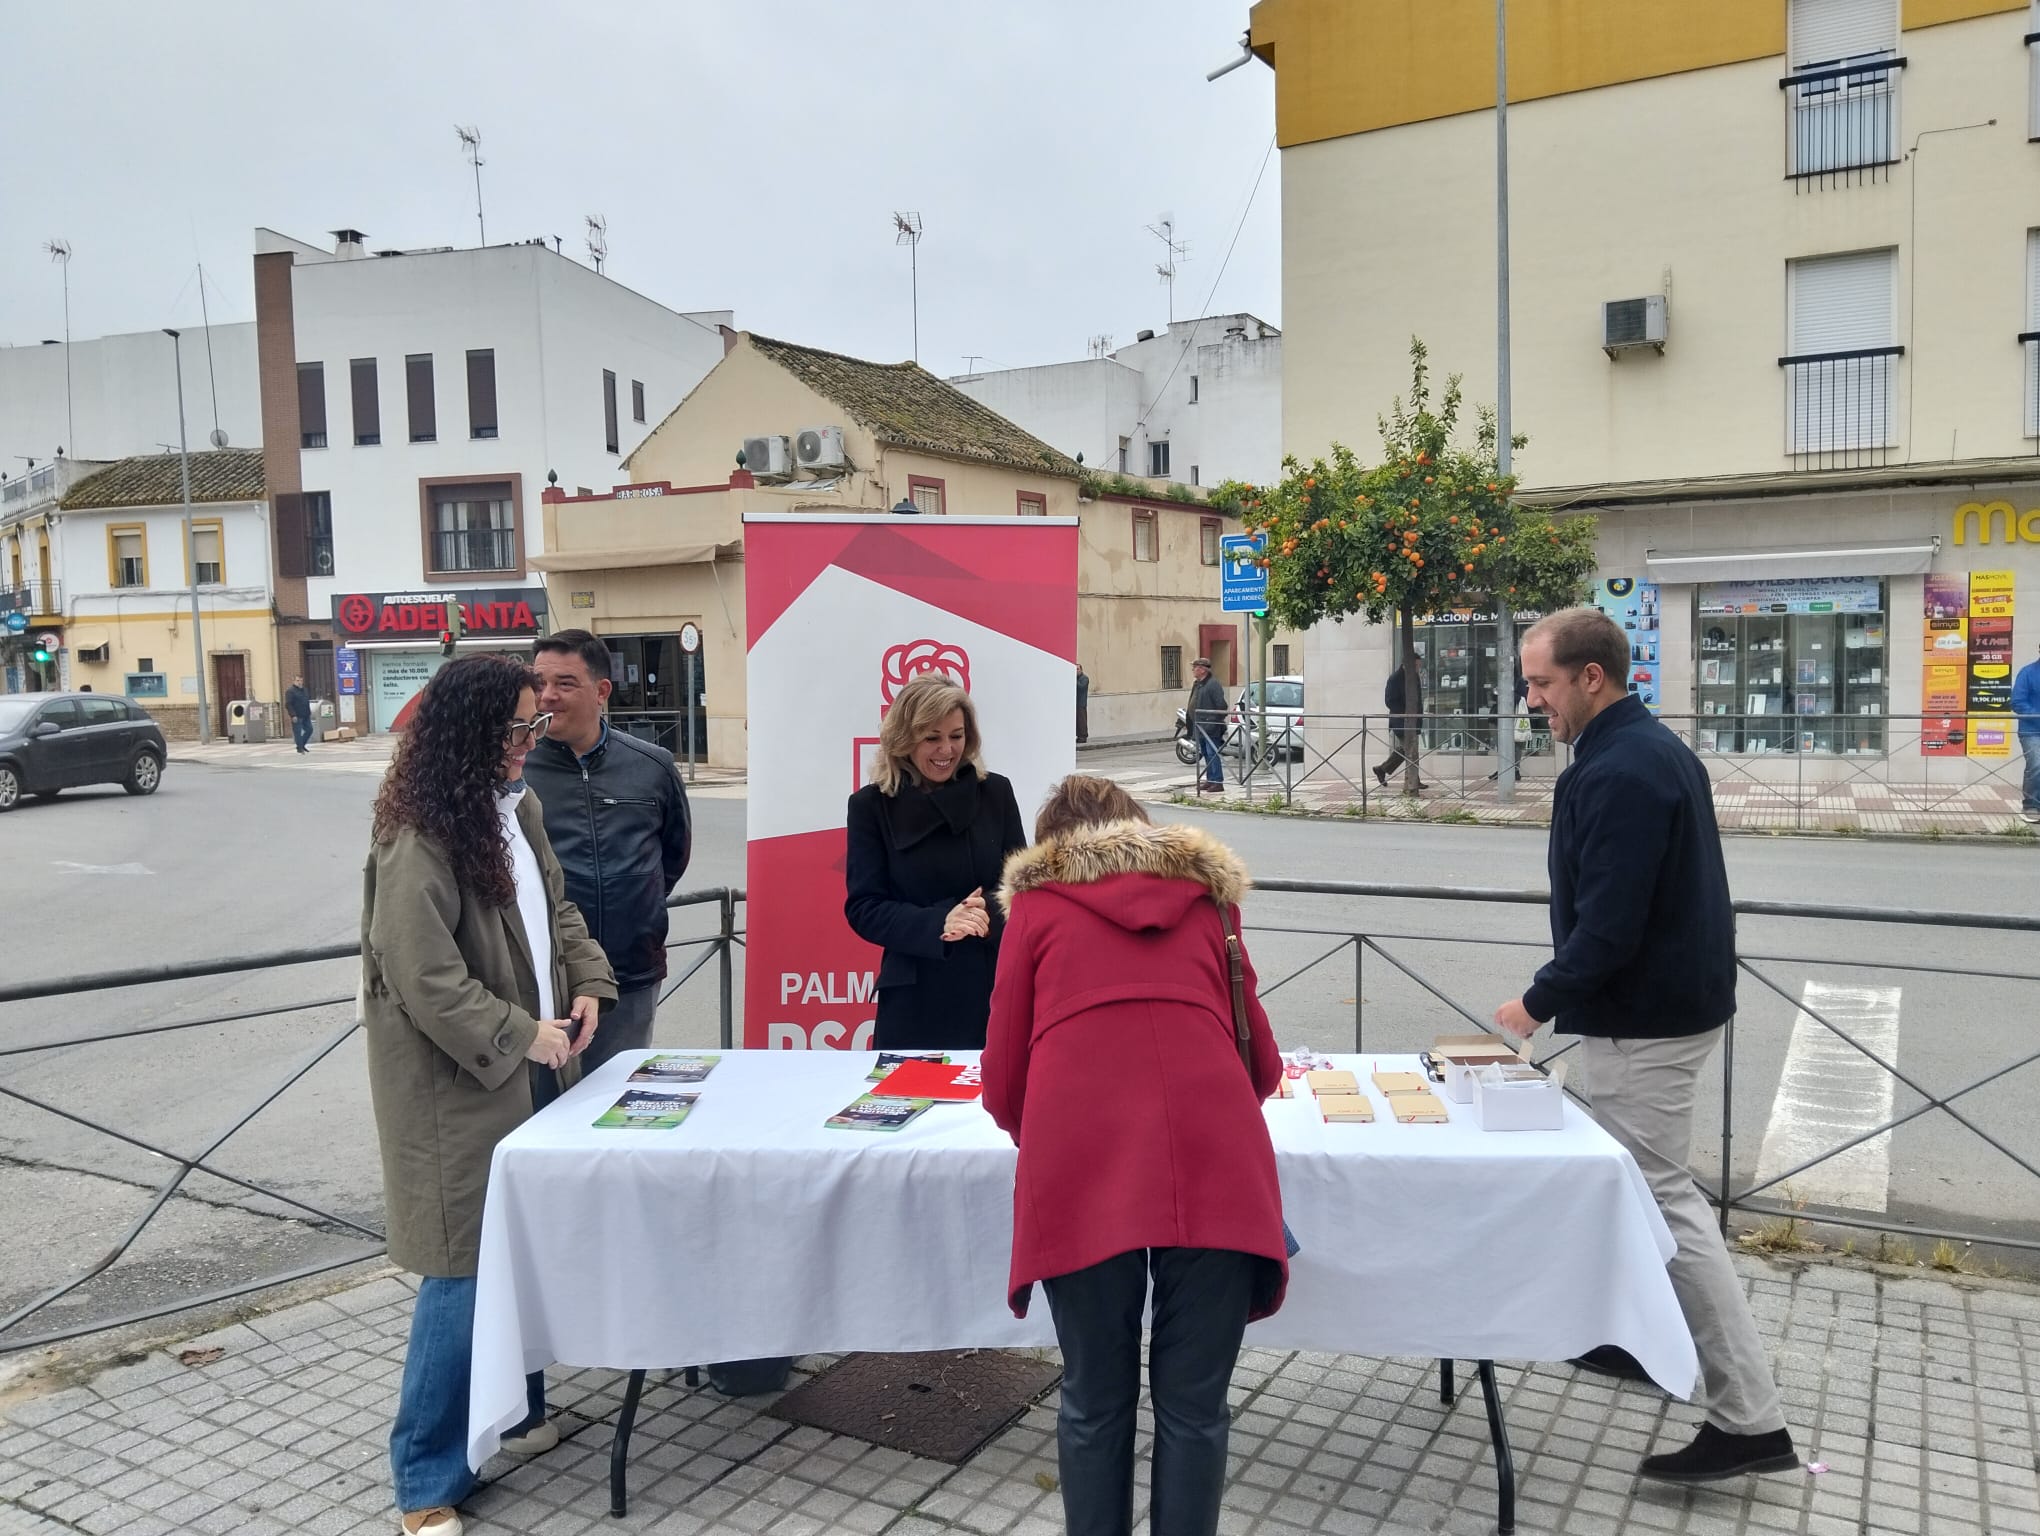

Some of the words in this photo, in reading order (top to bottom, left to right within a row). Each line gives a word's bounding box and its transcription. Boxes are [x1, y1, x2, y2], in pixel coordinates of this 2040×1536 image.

[616, 490, 633, 500] BAR
[640, 487, 662, 498] ROSA
[1224, 586, 1265, 594] APARCAMIENTO
[383, 594, 456, 605] AUTOESCUELAS
[1491, 609, 1541, 621] MVILES
[781, 971, 879, 1005] PALM
